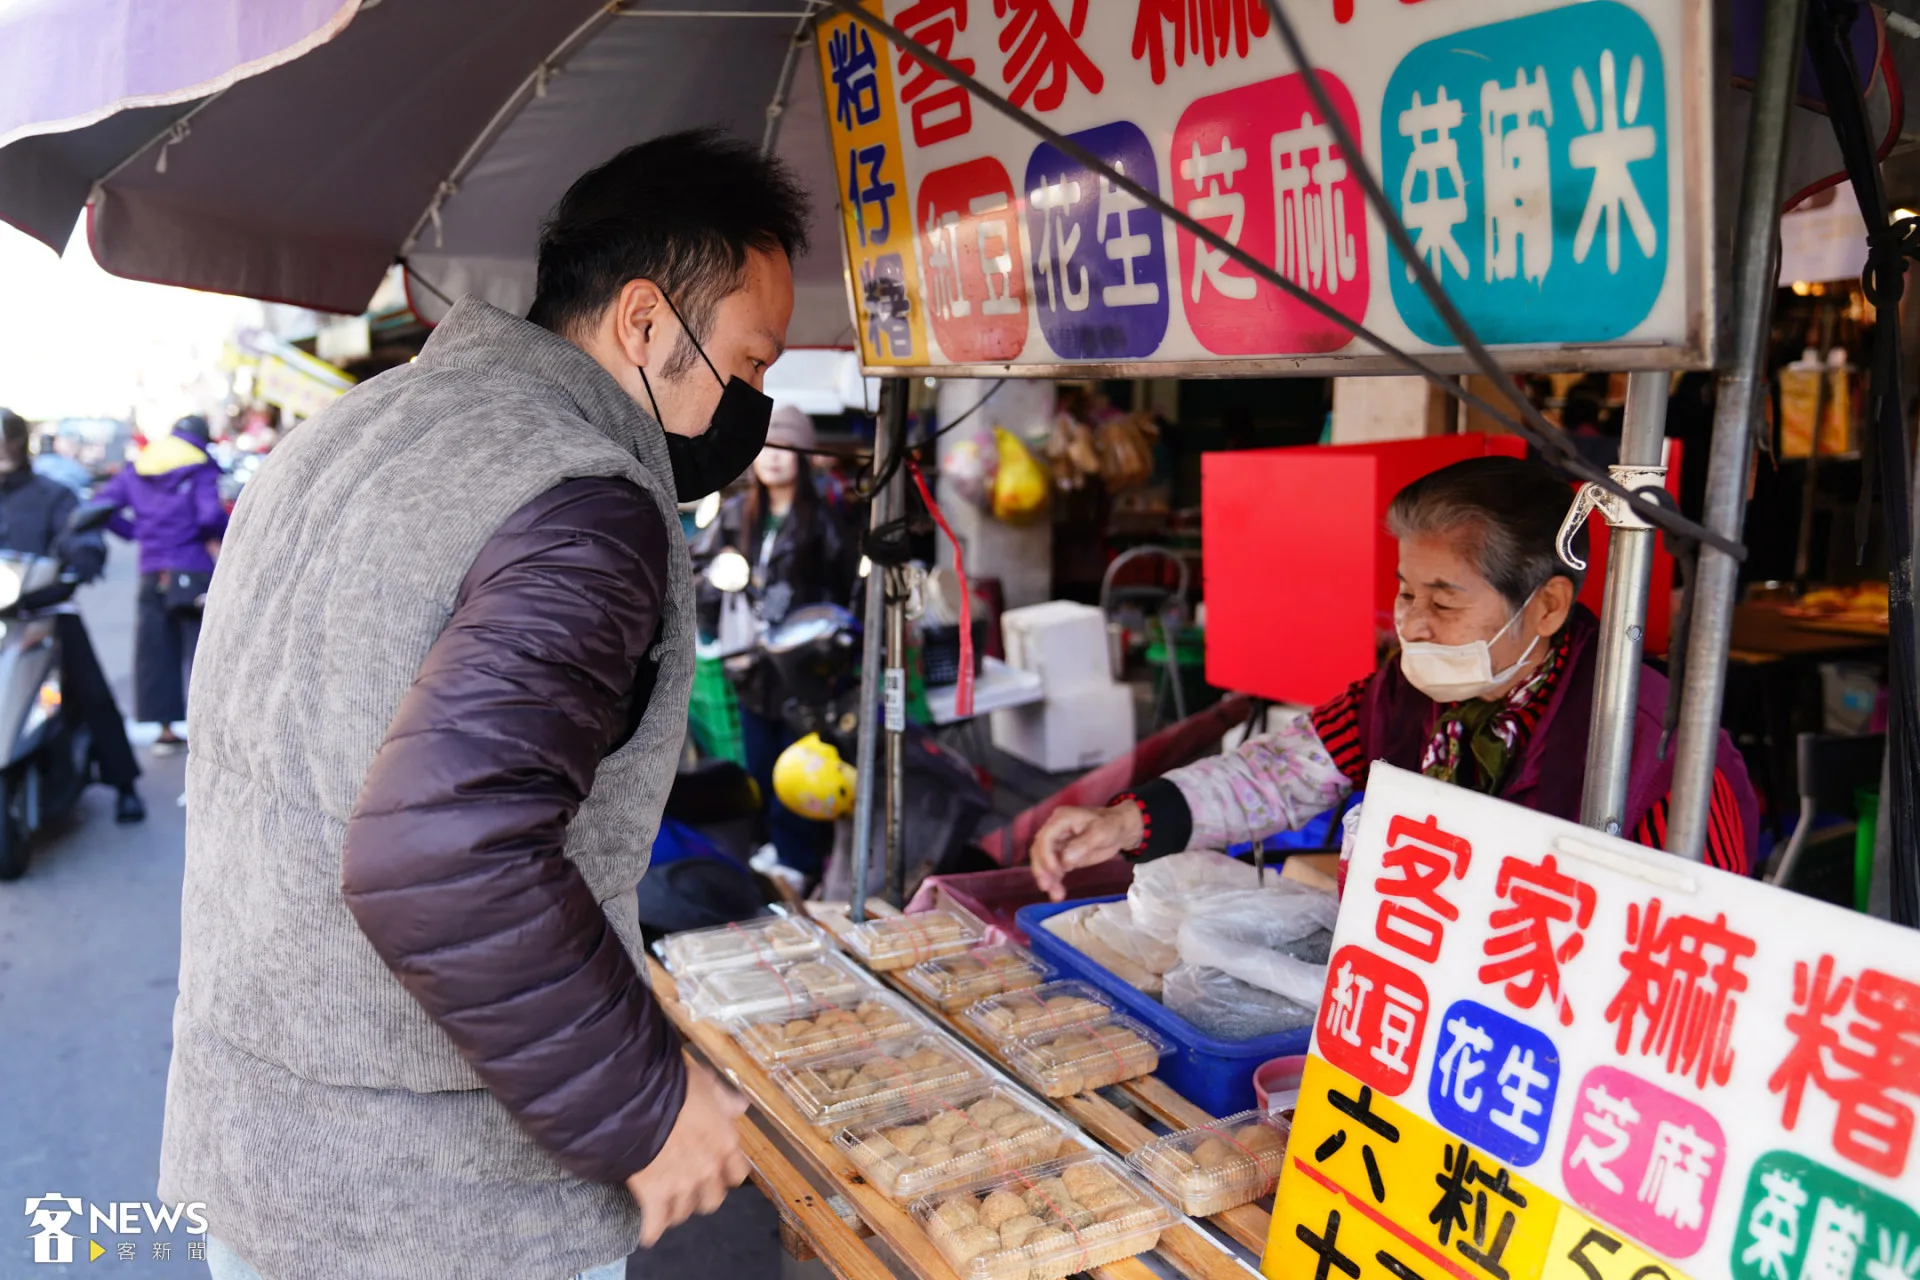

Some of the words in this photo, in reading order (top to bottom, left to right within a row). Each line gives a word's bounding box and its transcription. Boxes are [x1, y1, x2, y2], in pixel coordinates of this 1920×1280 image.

[926, 191, 1021, 320] 紅豆
[1030, 161, 1159, 314] 花生
[1180, 112, 1357, 304] 芝麻
[1314, 1085, 1528, 1280] 六粒
[1324, 959, 1424, 1078] 紅豆
[1438, 1015, 1552, 1146] 花生
[1568, 1084, 1717, 1231] 芝麻
